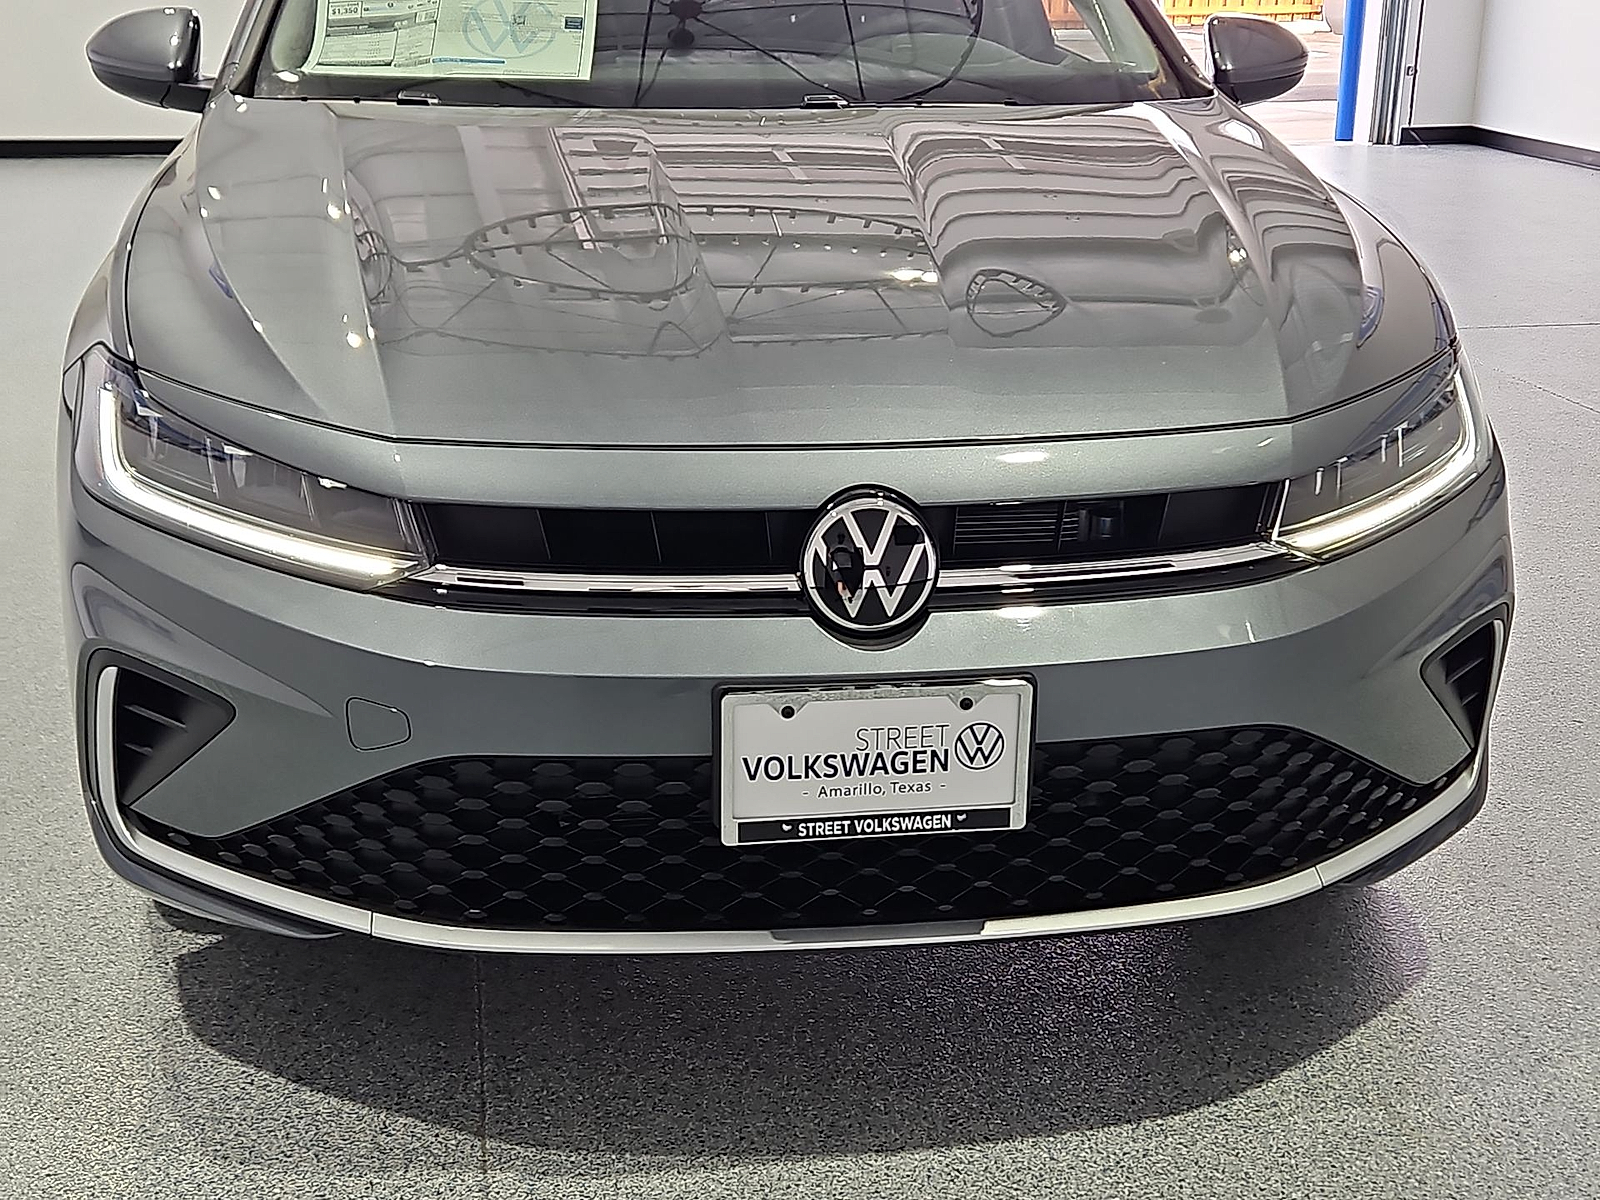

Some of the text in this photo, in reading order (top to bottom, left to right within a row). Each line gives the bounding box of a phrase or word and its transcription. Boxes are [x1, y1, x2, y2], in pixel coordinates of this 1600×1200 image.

[806, 500, 935, 629] VW
[855, 724, 950, 752] STREET
[954, 722, 1005, 771] VW
[742, 748, 950, 782] VOLKSWAGEN
[817, 781, 932, 799] Amarillo, Texas
[798, 814, 952, 837] STREET VOLKSWAGEN
